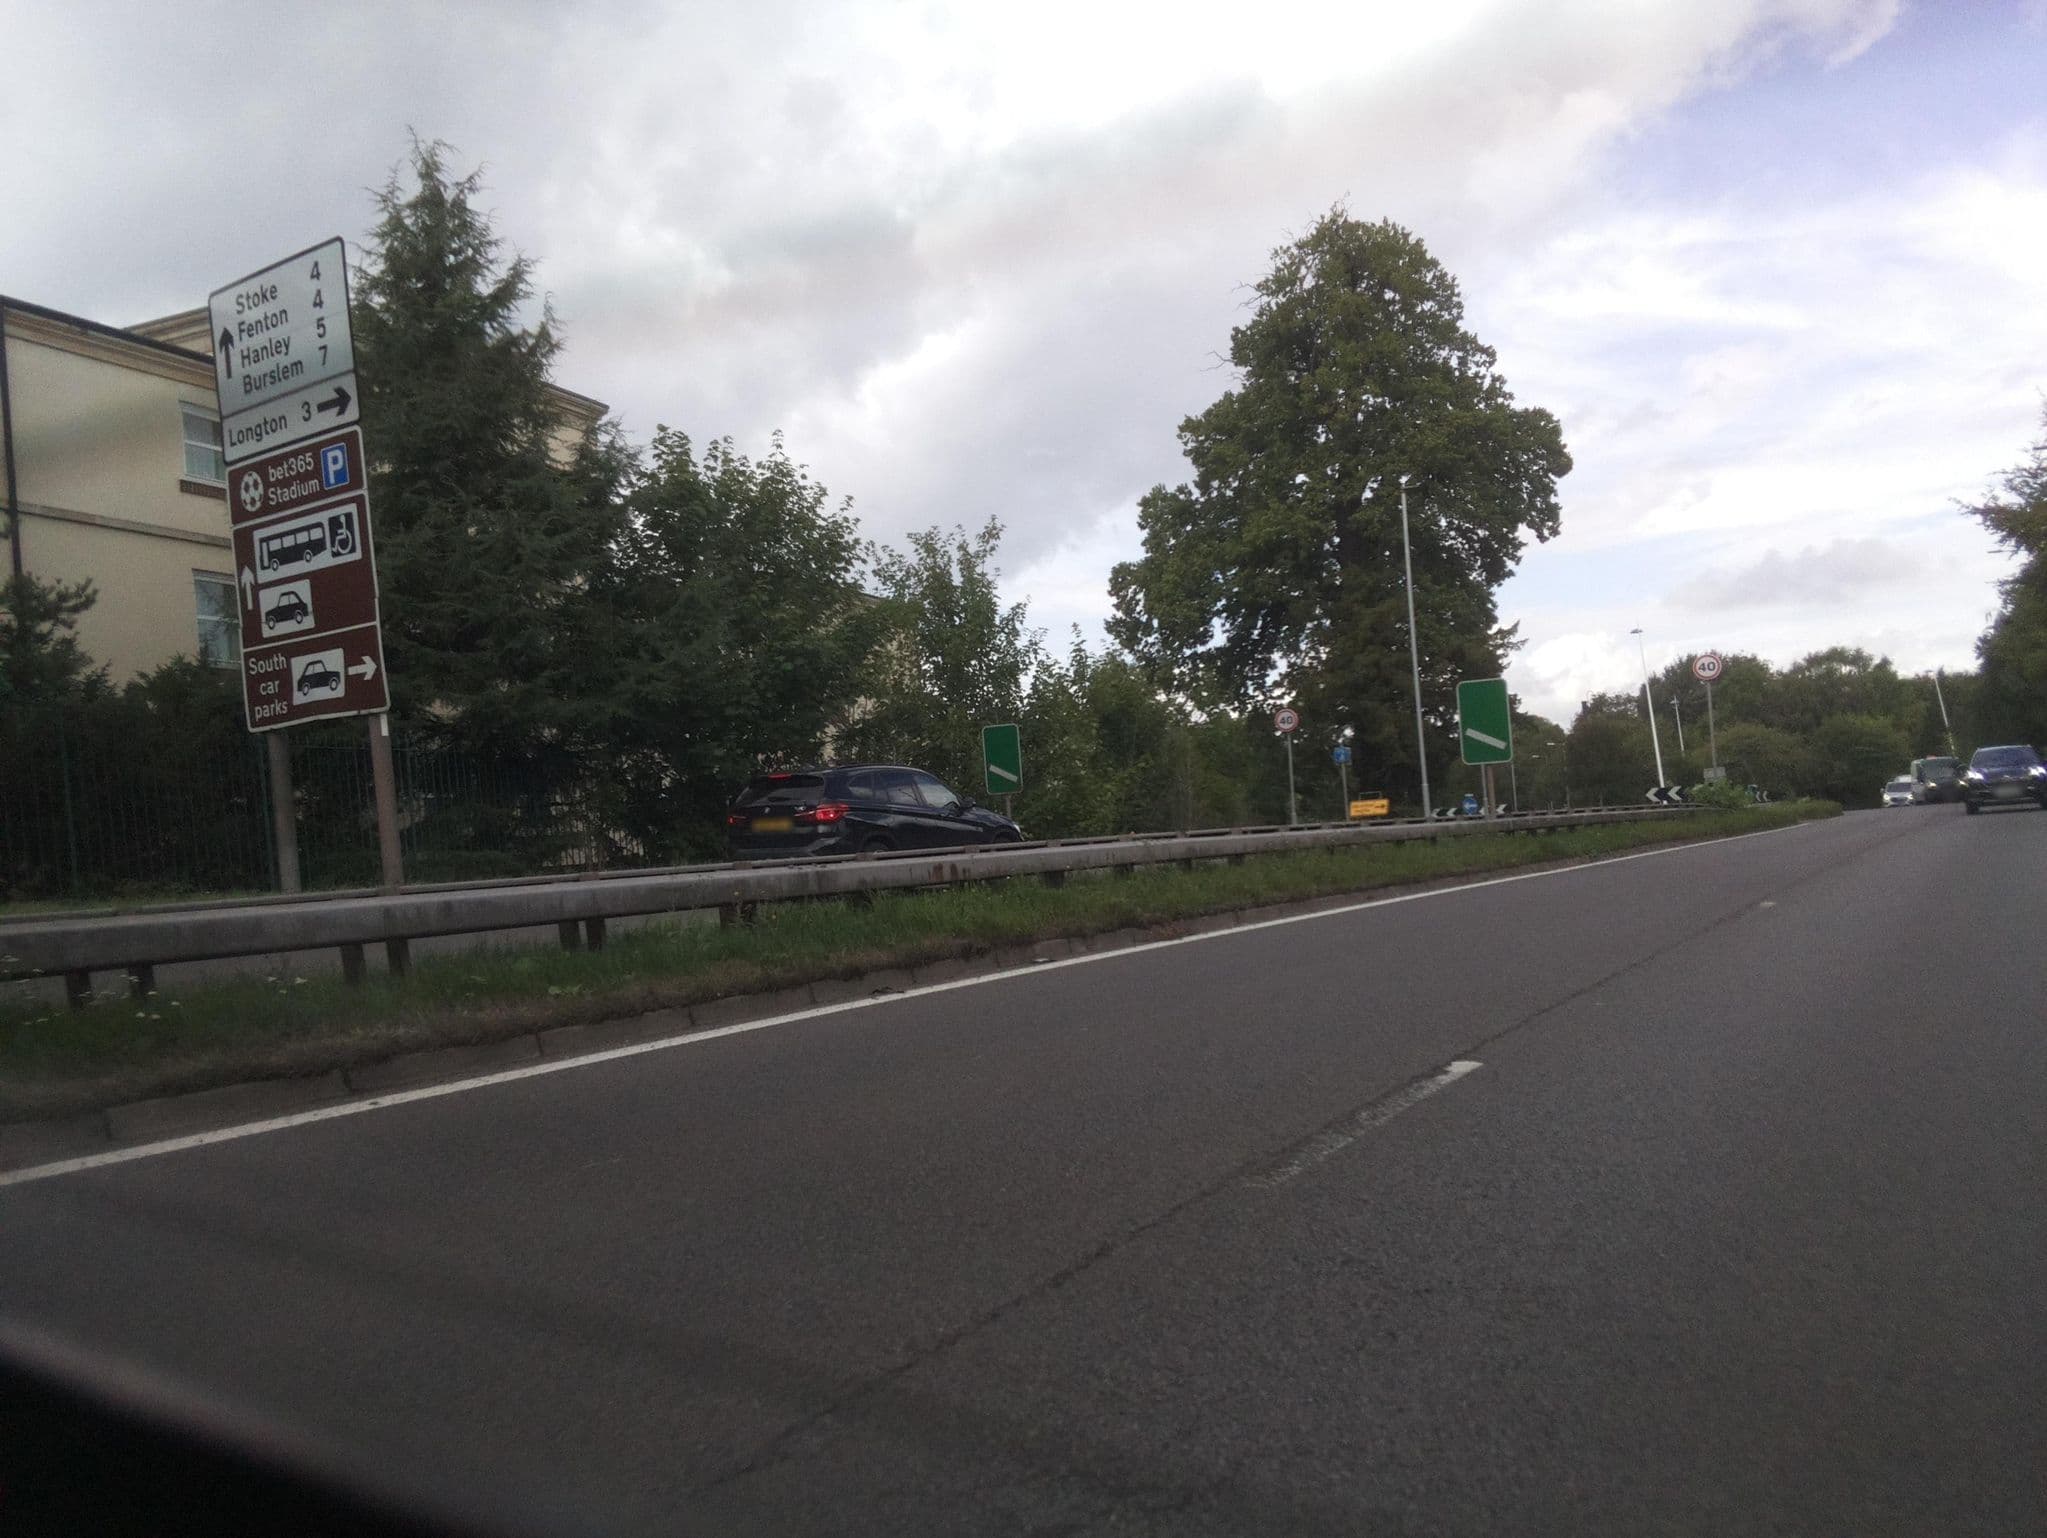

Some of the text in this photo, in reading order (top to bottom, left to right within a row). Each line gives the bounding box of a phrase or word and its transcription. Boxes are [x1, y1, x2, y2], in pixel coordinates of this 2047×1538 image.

[235, 260, 321, 315] Stoke 4
[237, 289, 324, 342] Fenton 4
[240, 316, 326, 369] Hanley 5
[242, 345, 328, 394] Burslem 7
[229, 401, 312, 447] Longton 3
[267, 452, 315, 482] bet365
[326, 448, 344, 485] P
[267, 476, 320, 506] Stadium
[249, 652, 287, 675] South
[1698, 661, 1716, 672] 40
[259, 678, 280, 695] car
[254, 699, 289, 723] parks
[1279, 715, 1293, 725] 40
